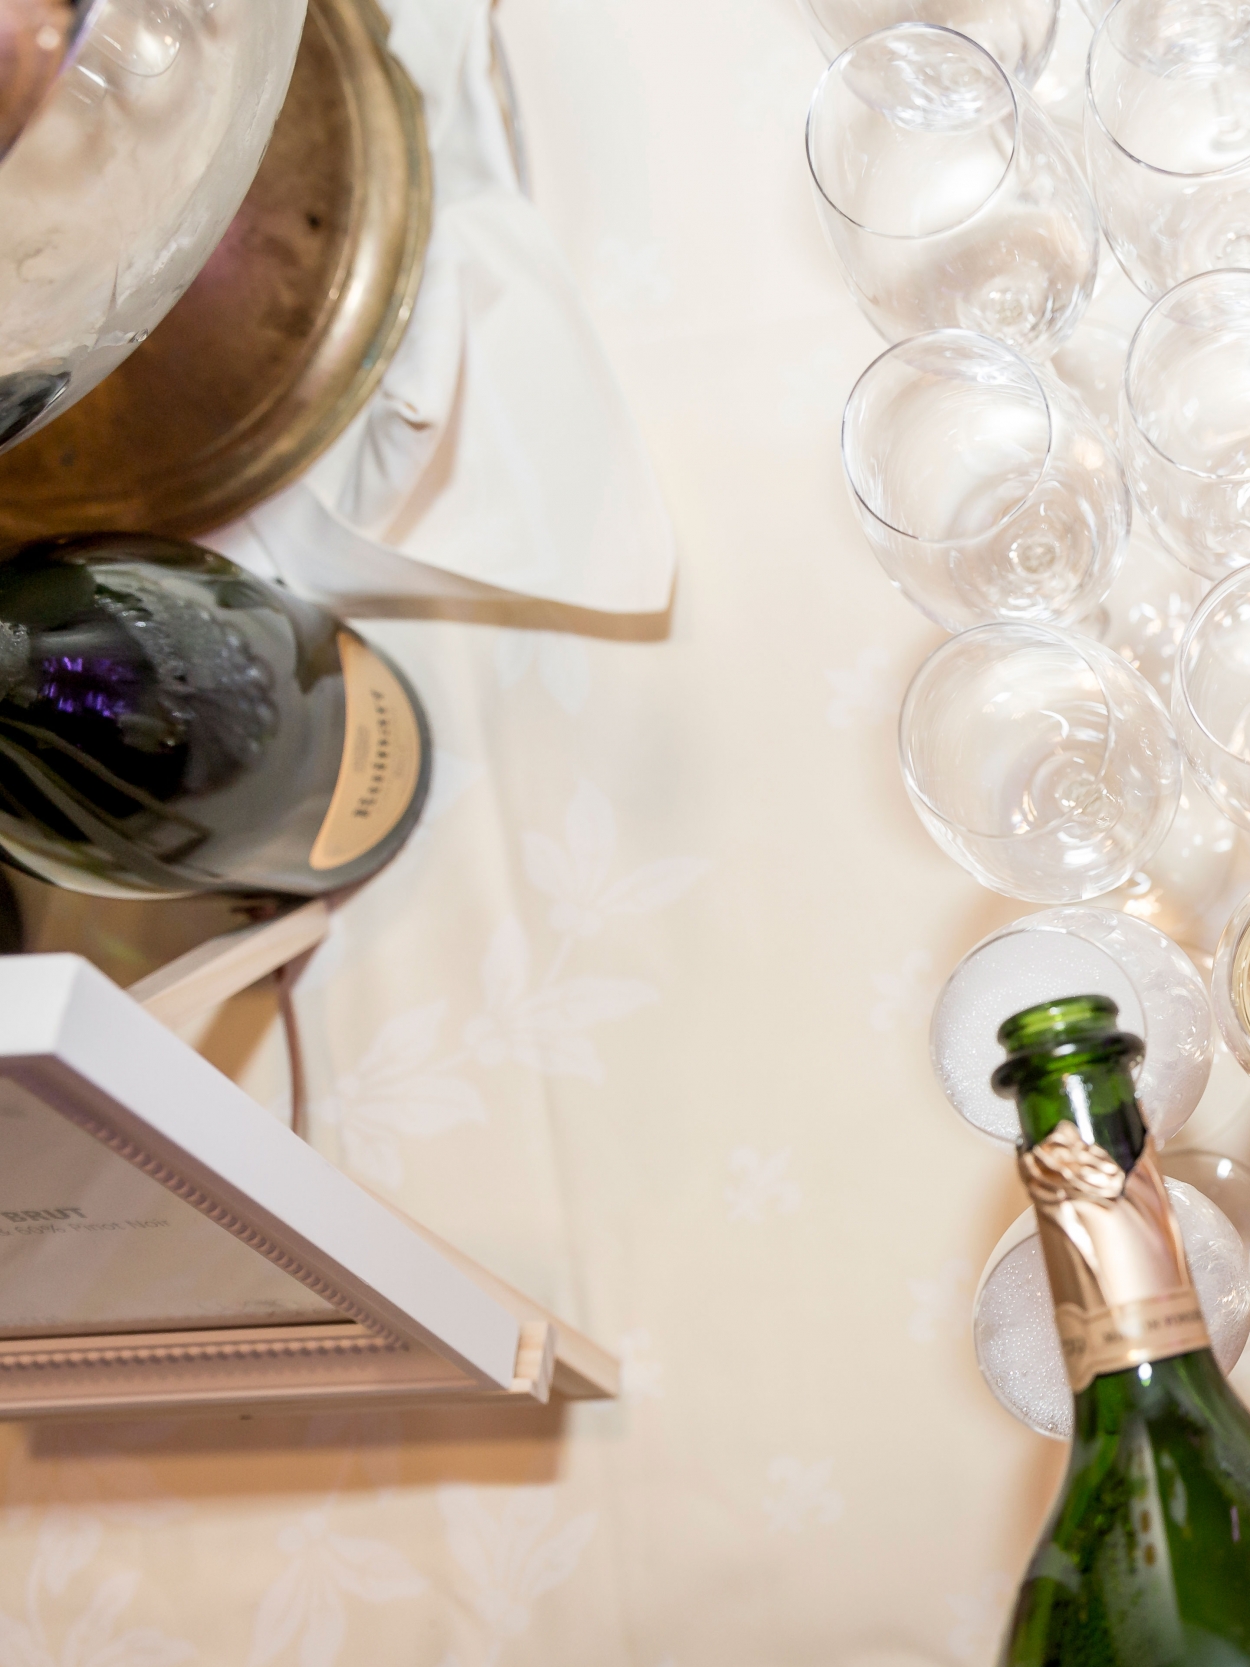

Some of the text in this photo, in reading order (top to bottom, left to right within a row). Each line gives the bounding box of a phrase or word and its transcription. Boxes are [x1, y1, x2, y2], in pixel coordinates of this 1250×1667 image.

[1, 1207, 87, 1223] BRUT
[67, 1222, 126, 1232] Pinot
[125, 1219, 170, 1230] Noir
